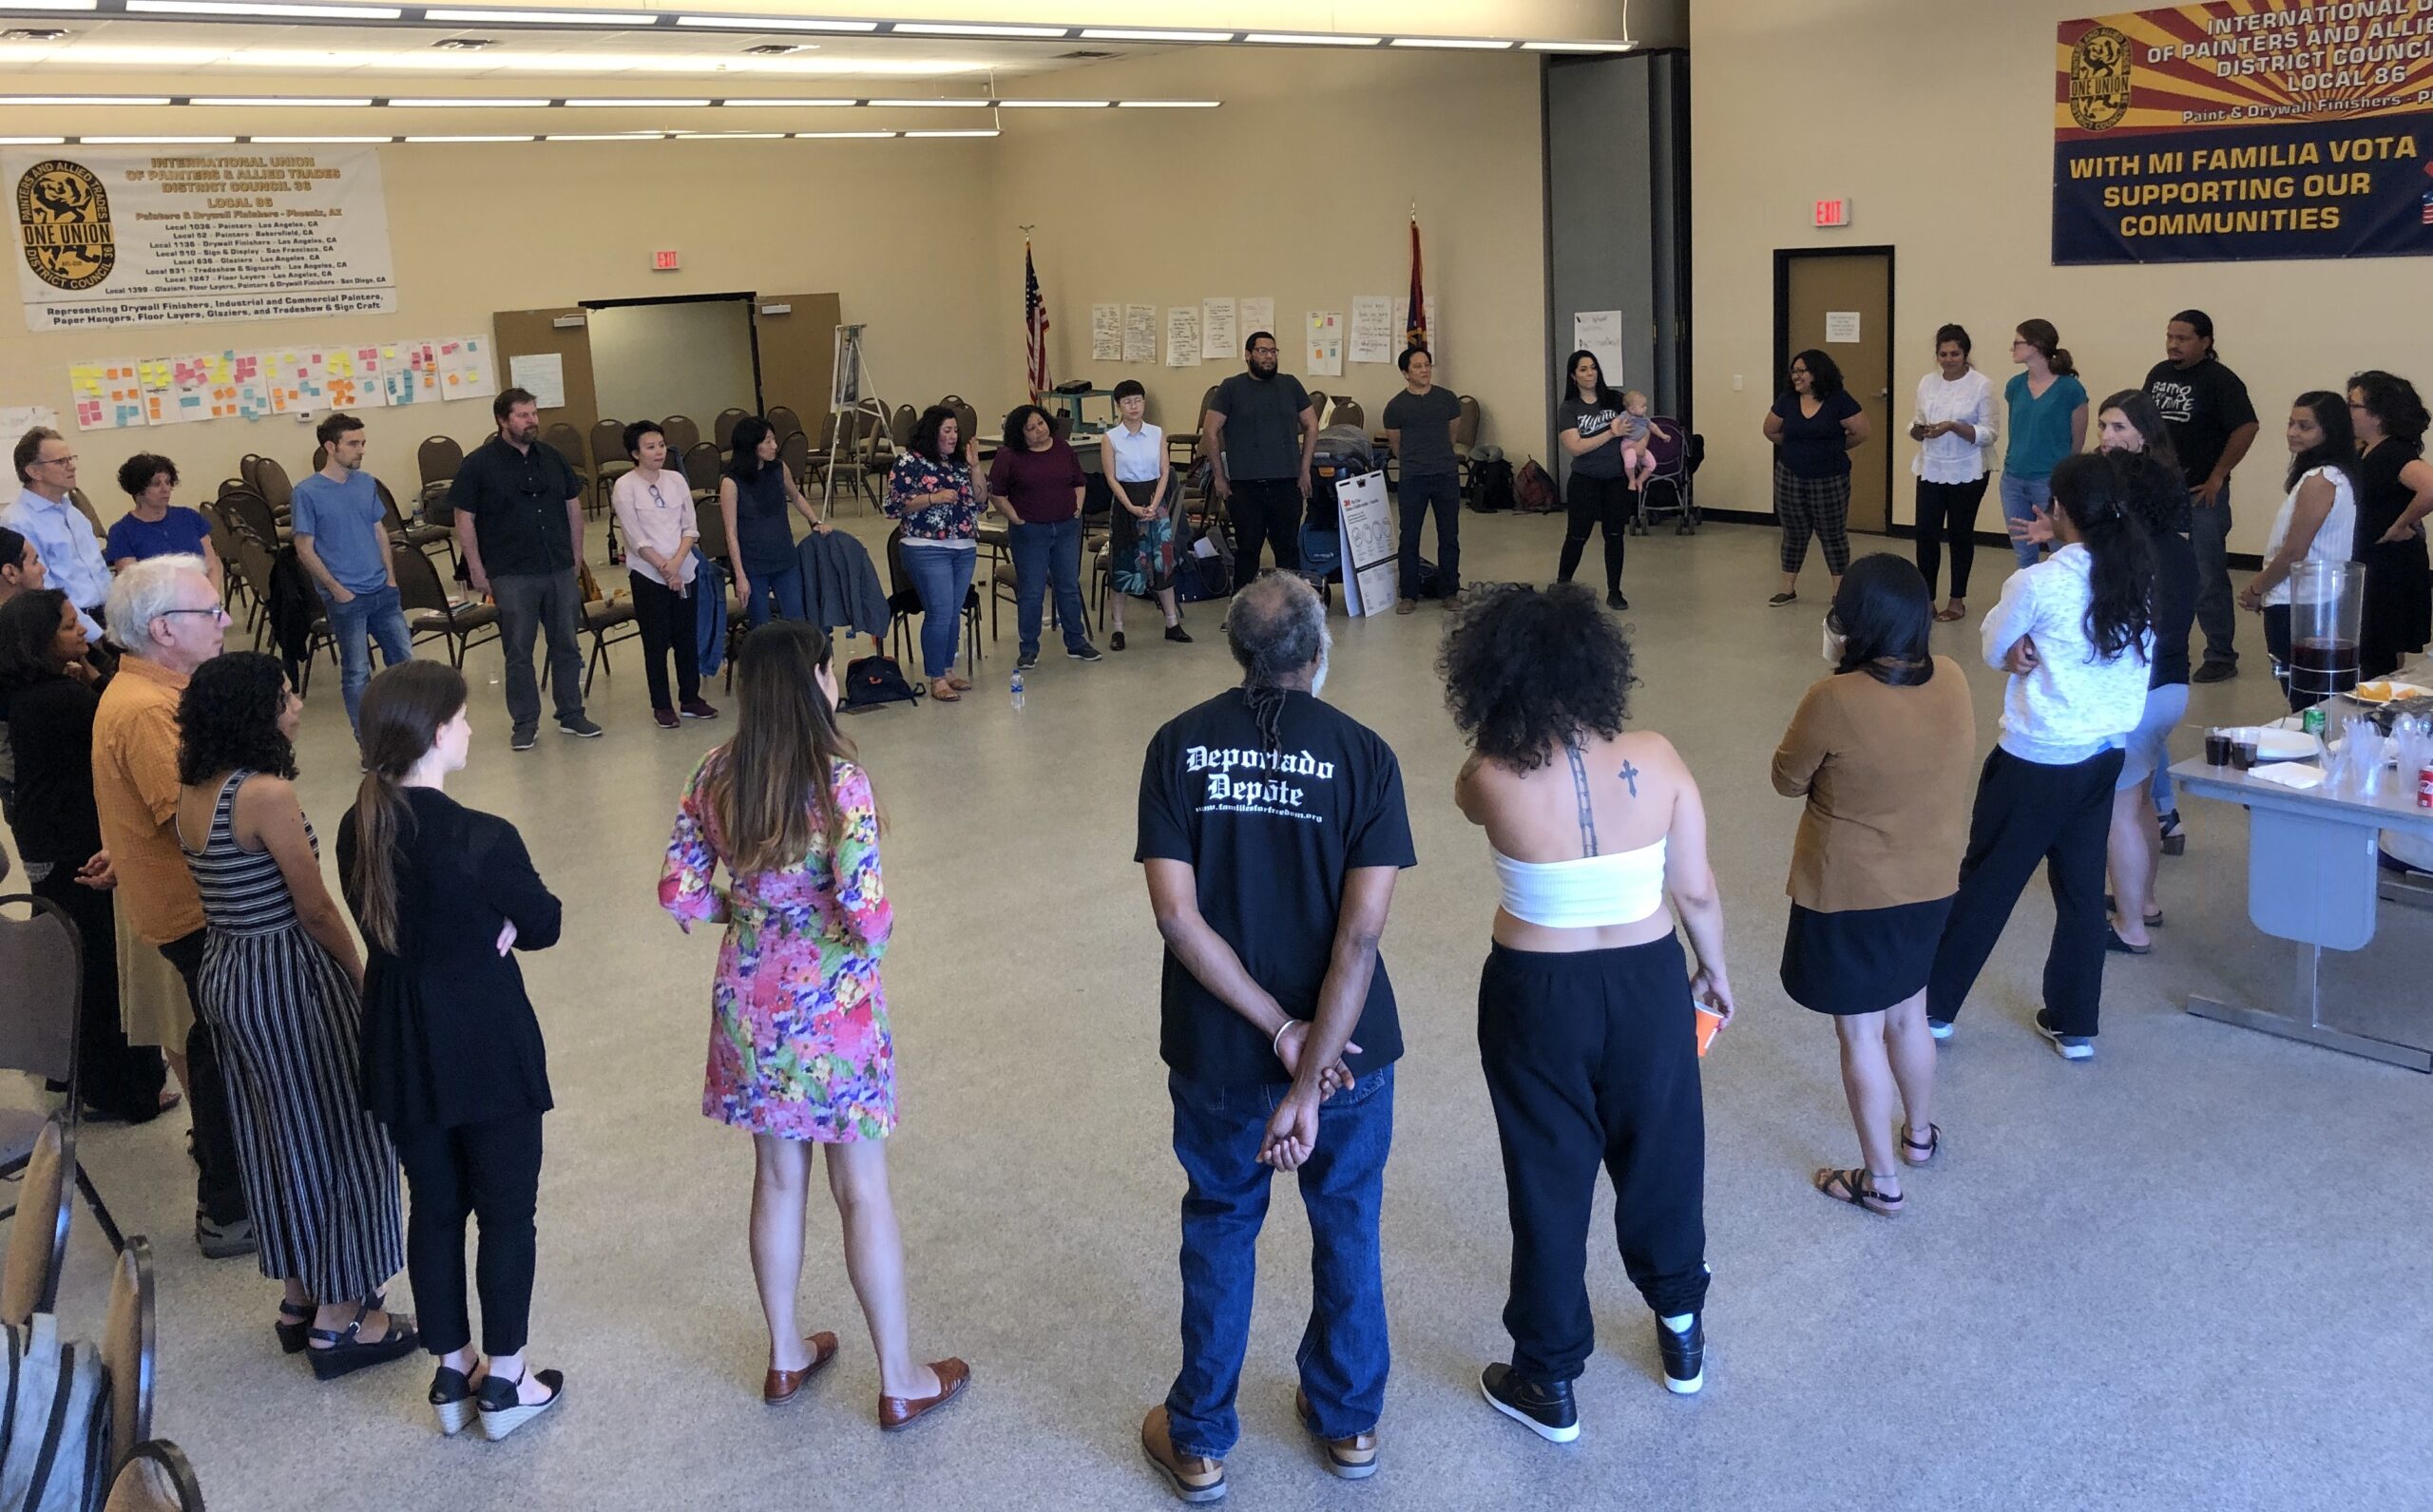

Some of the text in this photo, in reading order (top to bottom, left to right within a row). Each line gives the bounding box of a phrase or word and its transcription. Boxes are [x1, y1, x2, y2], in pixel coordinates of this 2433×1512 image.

[2207, 0, 2408, 35] INTERNATIONAL
[2148, 46, 2174, 63] OF
[2181, 32, 2298, 59] PAINTERS
[2307, 26, 2360, 46] AND
[2216, 49, 2326, 77] DISTRICT
[2072, 76, 2129, 97] ONE UNION
[2288, 66, 2406, 92] LOCAL 86
[2183, 109, 2226, 123] Paint
[2231, 106, 2242, 118] &
[2249, 101, 2311, 119] Drywall
[2319, 96, 2401, 111] Finishers
[151, 157, 316, 168] INTERNATIONAL UNION
[2070, 136, 2418, 179] WITH MI FAMILIA VOTA
[125, 169, 341, 182] OF PAINTERS & ALLIED TRADES
[162, 182, 226, 193] DISTRICT
[230, 182, 292, 192] COUNCIL
[19, 163, 108, 221] PAINTERS AND ALLIED TRADES
[2103, 172, 2371, 208] SUPPORTING OUR
[136, 212, 181, 220] Painters
[193, 211, 231, 220] Drywall
[233, 209, 279, 219] Finishers
[207, 197, 253, 208] LOCAL
[1816, 201, 1841, 224] EXIT
[2120, 206, 2341, 237] COMMUNITIES
[24, 223, 111, 245] ONE UNION
[27, 246, 114, 289] DISTRICT COUNCIL 36
[657, 251, 677, 268] EXIT
[47, 305, 118, 316] Representing
[121, 302, 161, 314] Drywall
[163, 301, 213, 311] Finishers,
[215, 298, 263, 307] Industrial
[266, 297, 283, 305] and
[285, 295, 338, 304] Commercial
[53, 316, 86, 326] Paper
[87, 314, 135, 324] Hangers,
[166, 310, 204, 320] Layers,
[207, 309, 251, 317] Glaziers,
[254, 307, 270, 316] and
[274, 305, 323, 315] Tradeshow
[335, 303, 354, 313] Sign
[1186, 745, 1334, 779] Deportado
